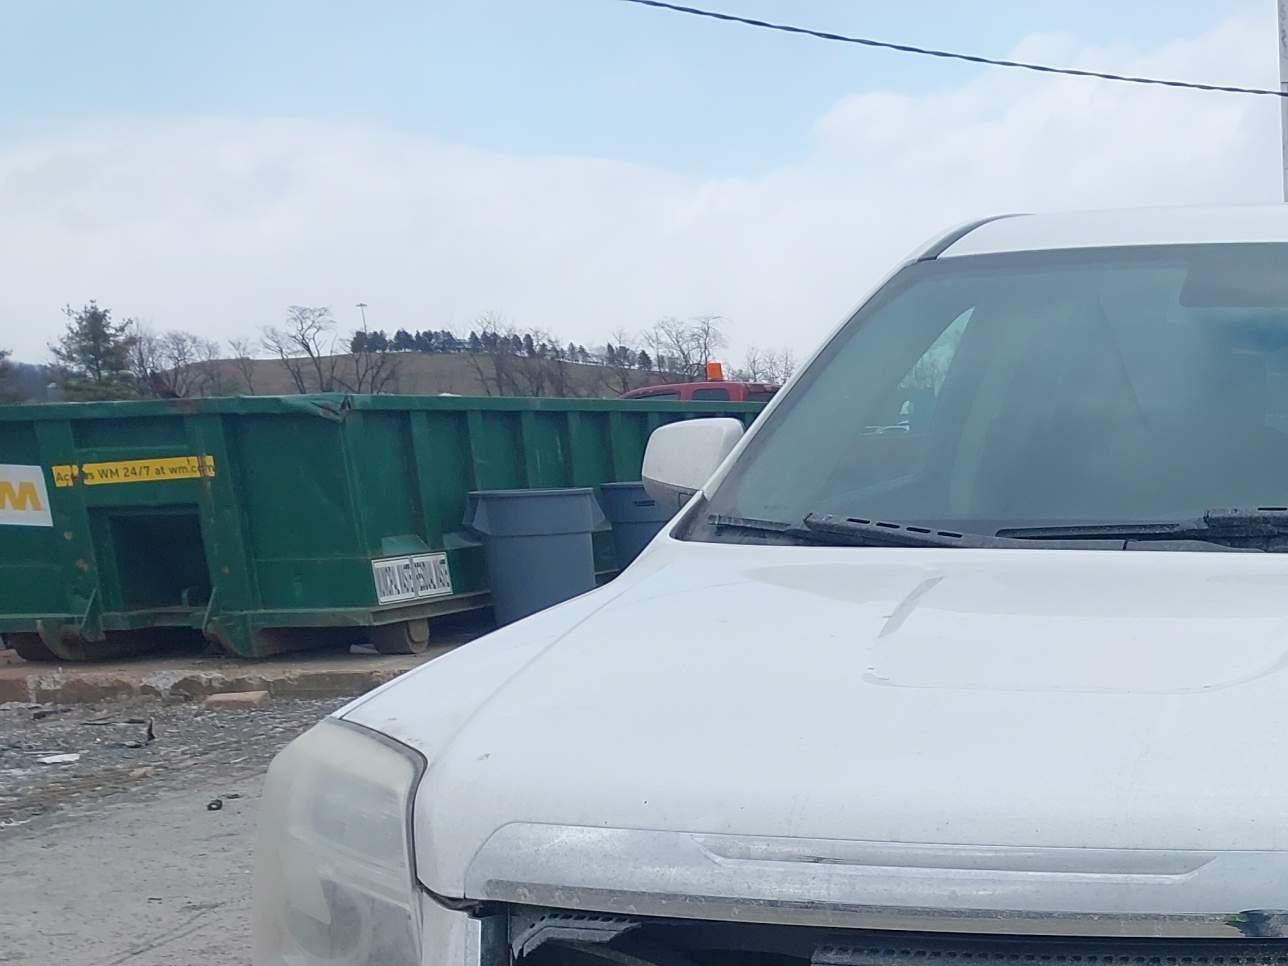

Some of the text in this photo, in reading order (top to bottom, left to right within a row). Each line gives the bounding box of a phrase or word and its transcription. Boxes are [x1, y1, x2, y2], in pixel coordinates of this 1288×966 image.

[97, 469, 119, 480] WM
[122, 466, 151, 478] 24/7
[154, 465, 166, 476] at
